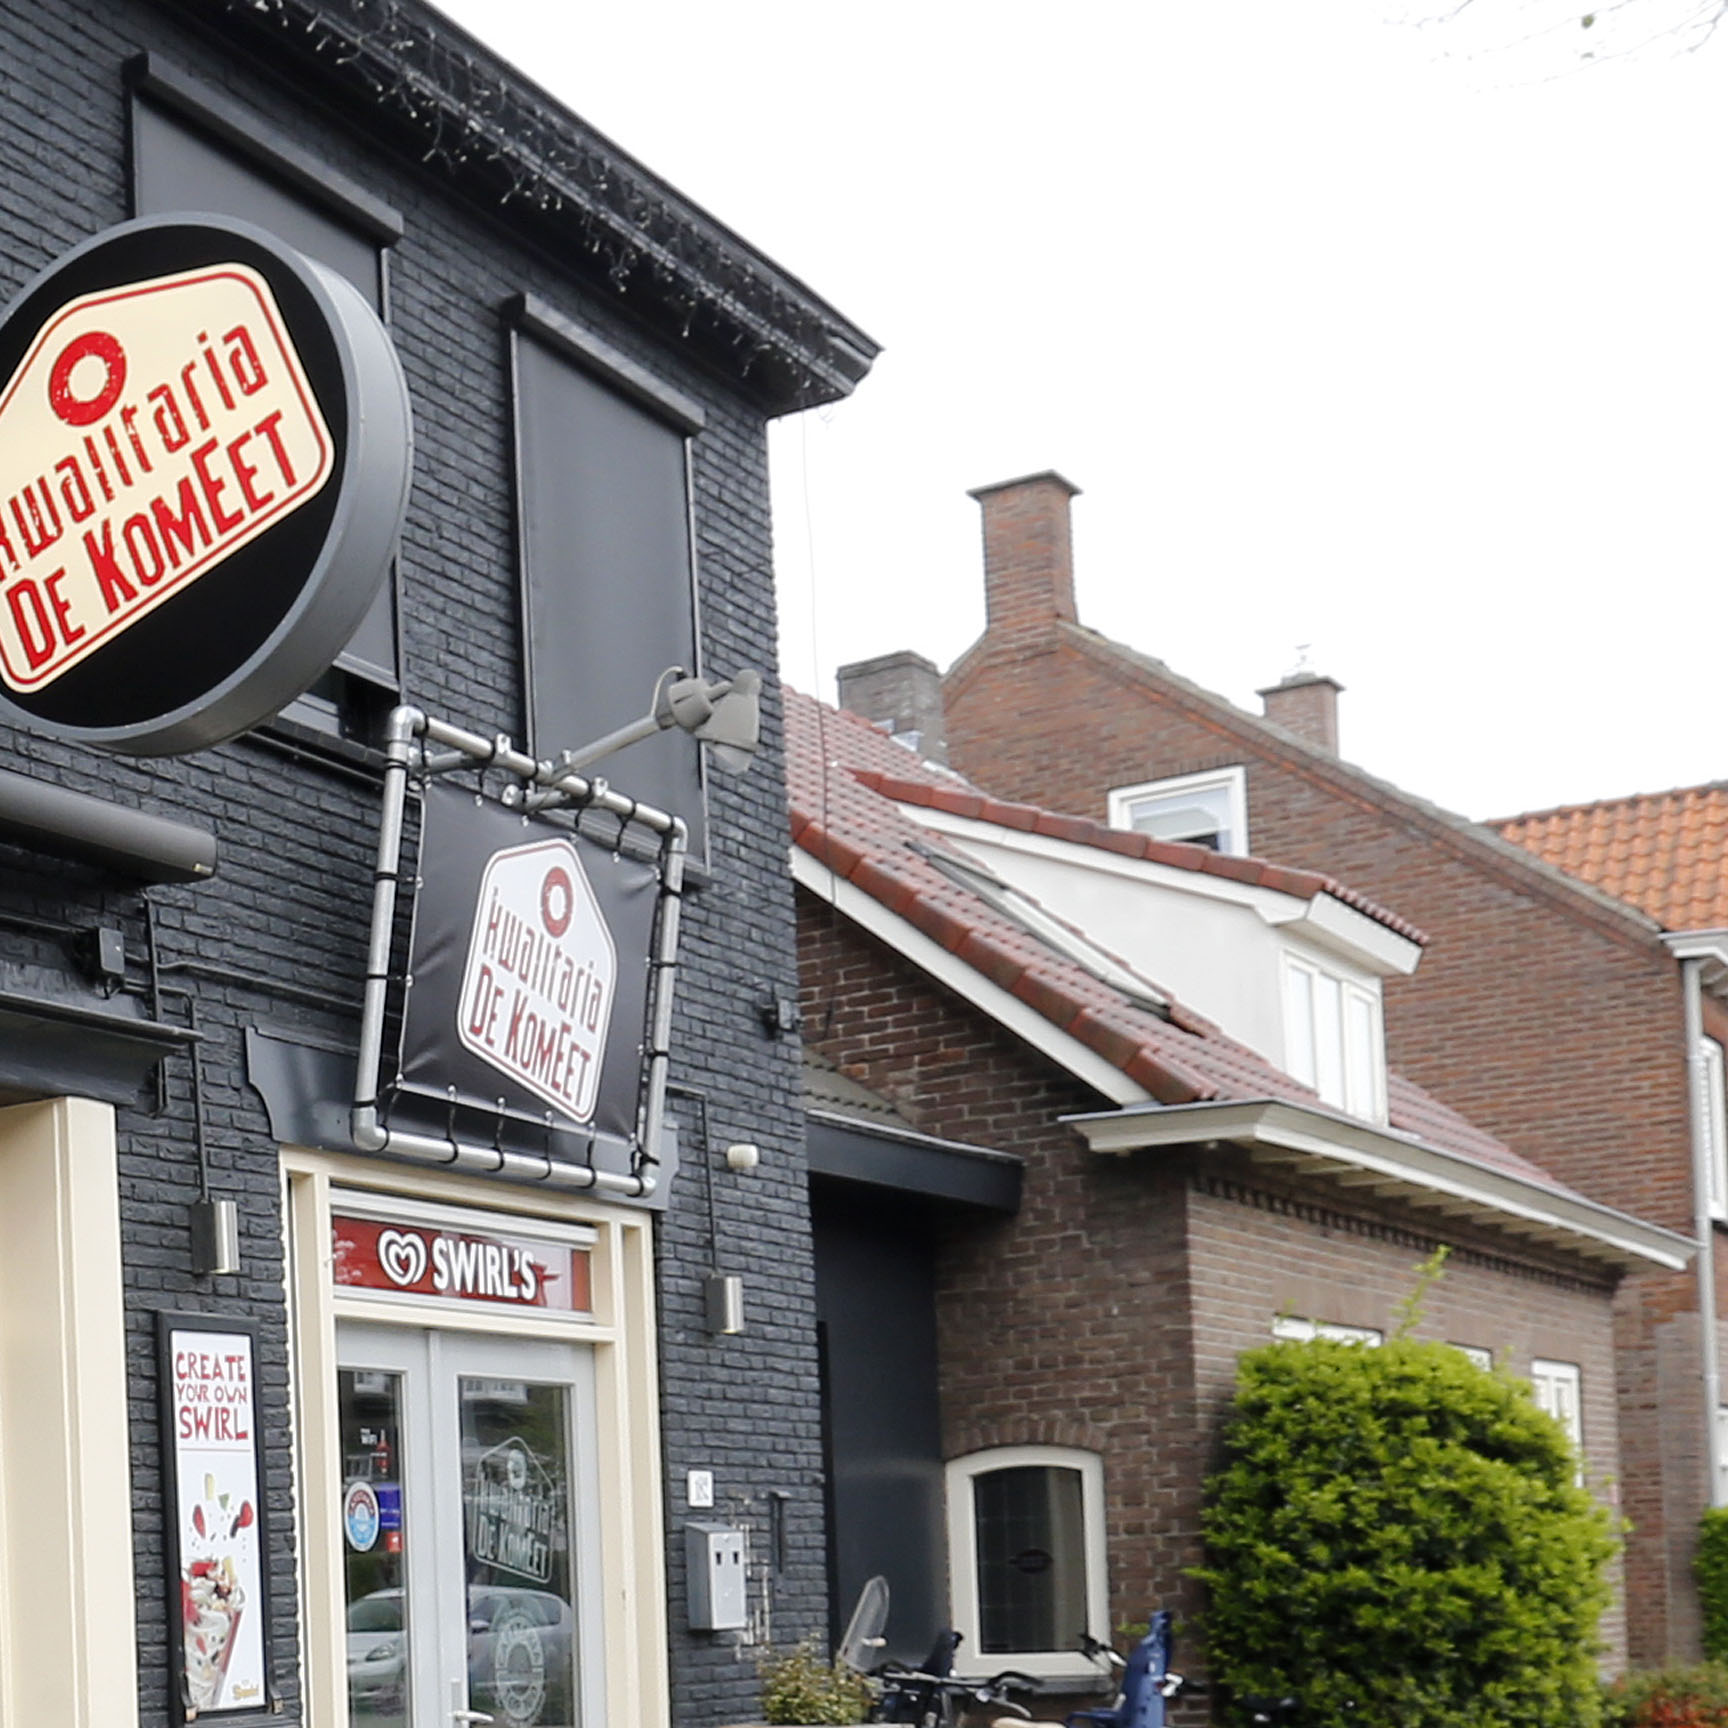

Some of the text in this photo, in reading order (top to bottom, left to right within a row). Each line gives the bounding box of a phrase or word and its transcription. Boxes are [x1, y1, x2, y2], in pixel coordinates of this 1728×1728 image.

[5, 409, 298, 672] DE KOMEET
[483, 886, 603, 1035] kwalitaria
[469, 962, 591, 1107] DE KOMEET
[431, 1236, 539, 1300] SWIRL'S
[175, 1351, 247, 1382] CREATE
[175, 1383, 248, 1405] YOUR OWN
[178, 1404, 249, 1441] SWIRL
